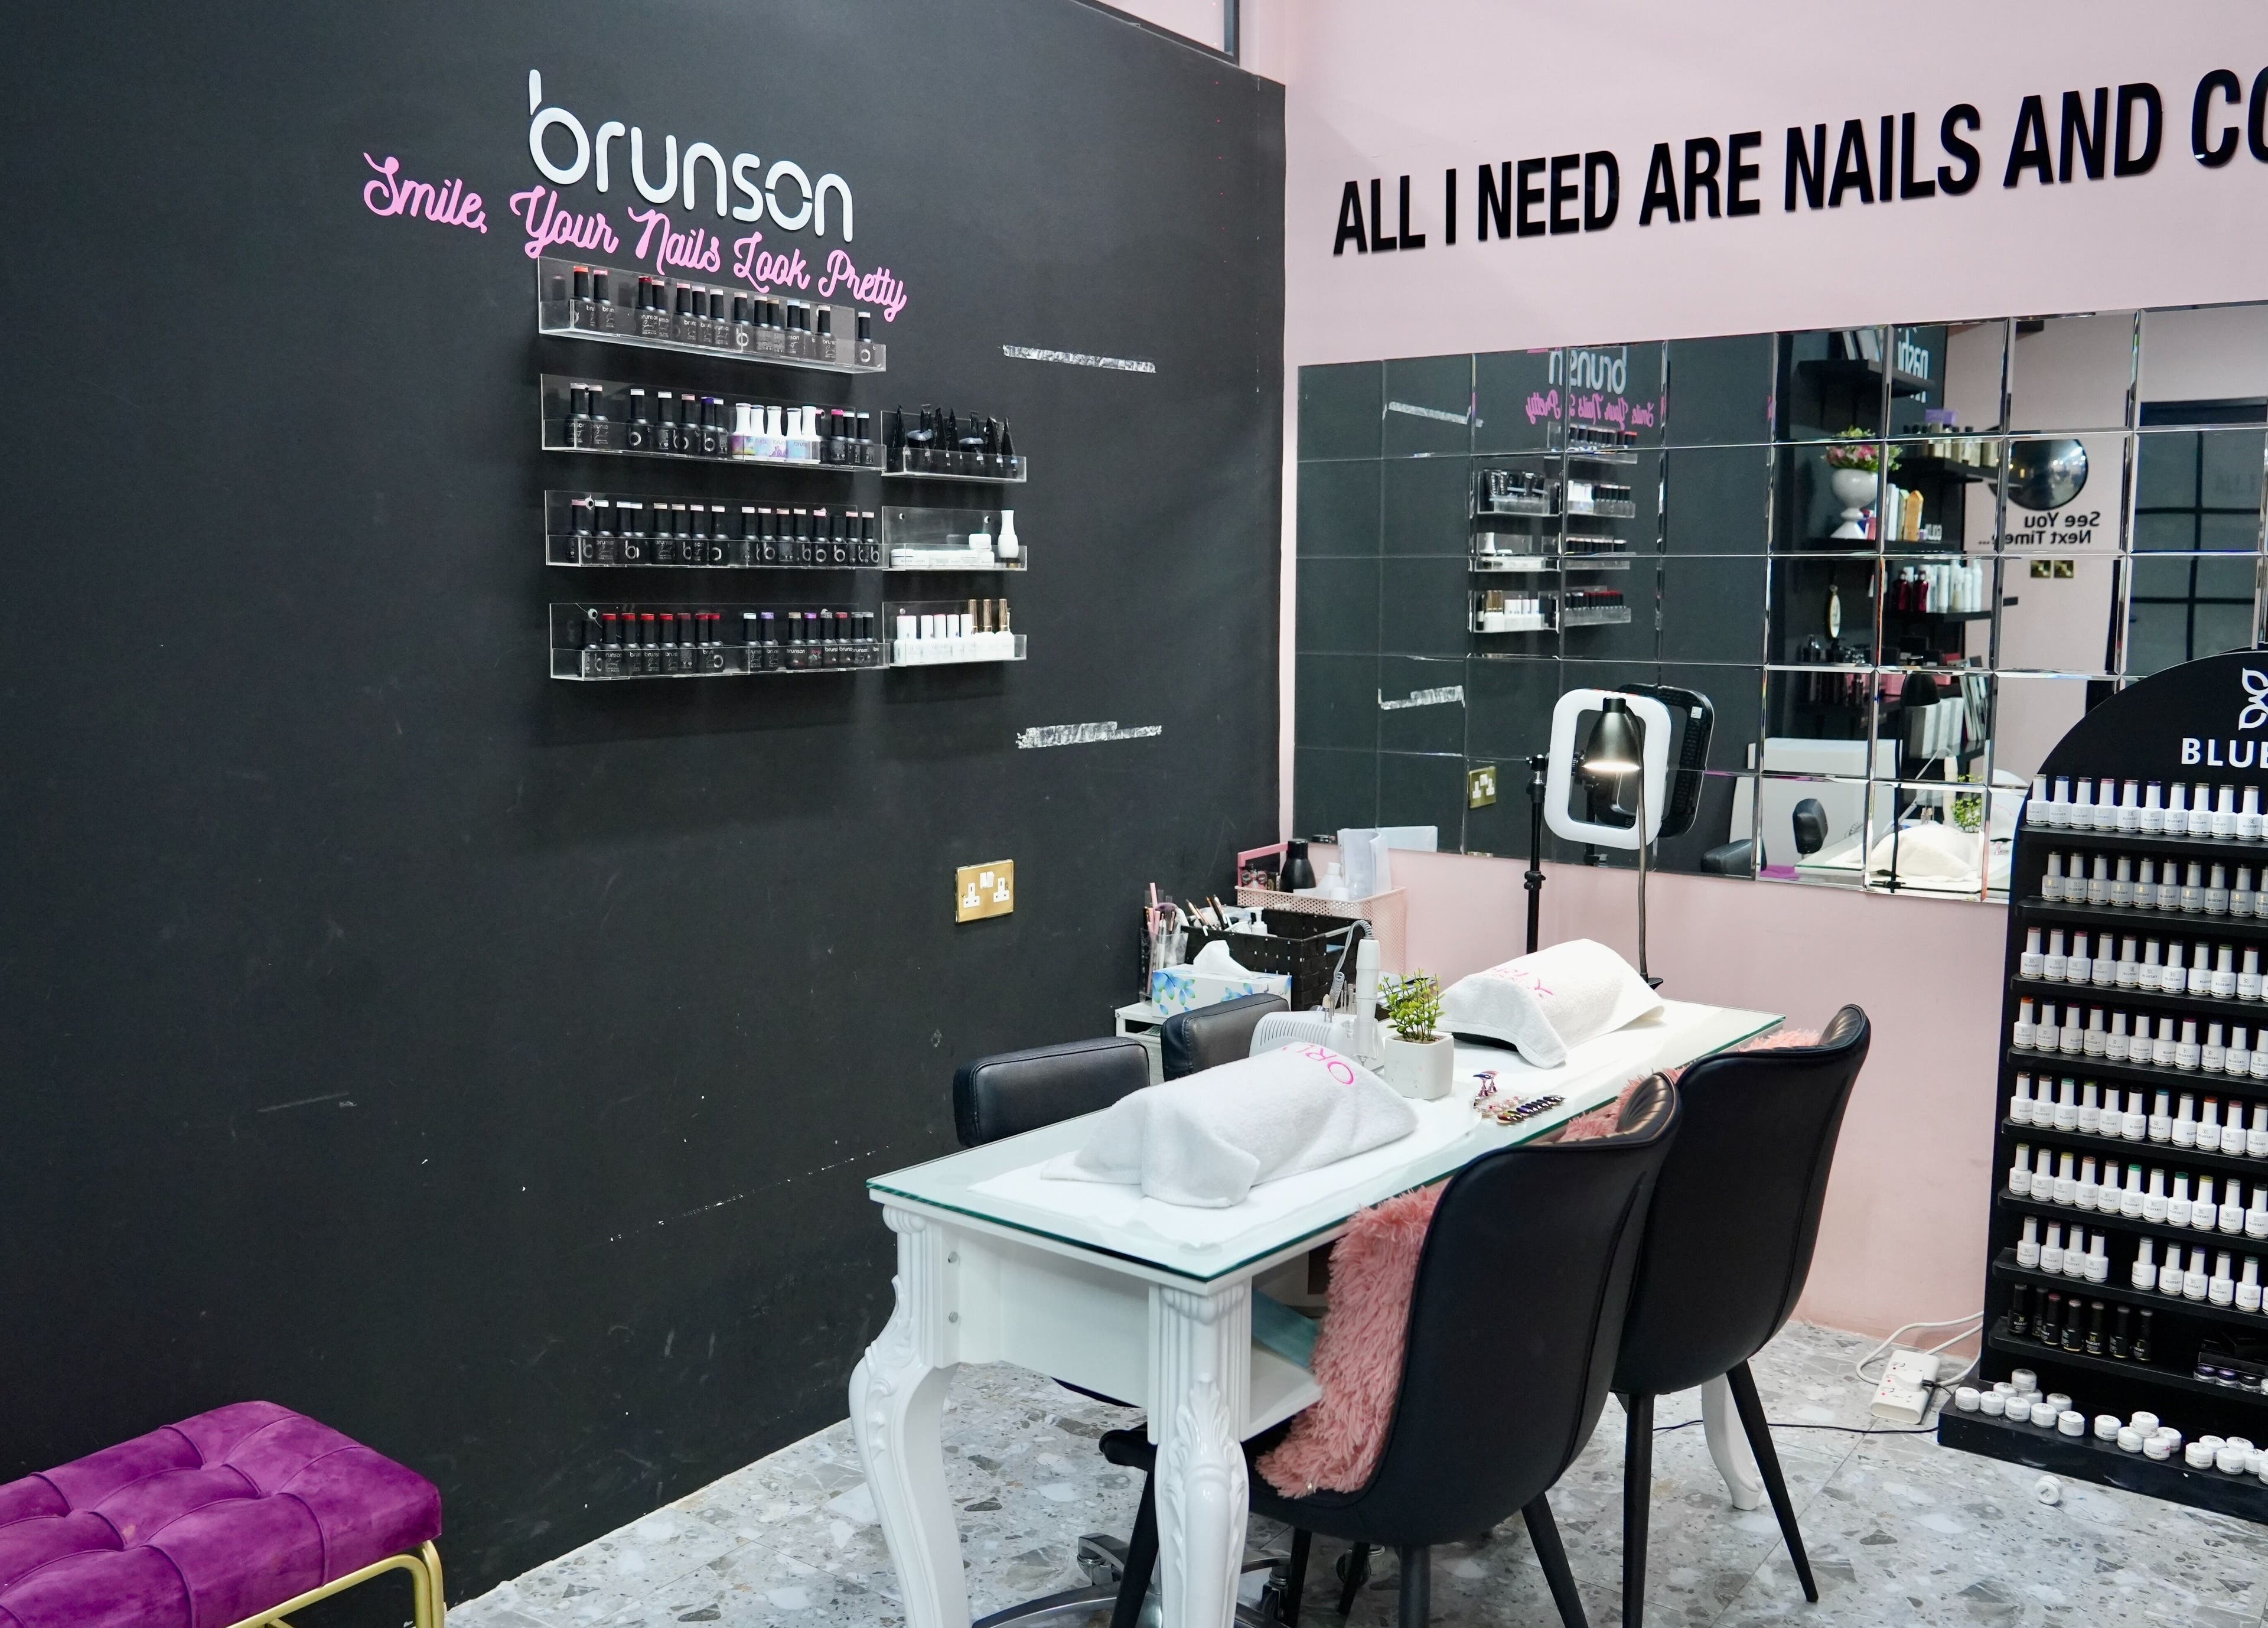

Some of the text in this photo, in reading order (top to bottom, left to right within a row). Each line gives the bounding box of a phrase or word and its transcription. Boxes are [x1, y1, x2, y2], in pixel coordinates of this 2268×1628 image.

[529, 69, 853, 242] brunson
[1333, 175, 1426, 255] ALL
[1445, 168, 1456, 246] I
[1478, 151, 1619, 242] NEED
[1639, 131, 1761, 226] ARE
[1784, 103, 1980, 212] NAILS
[2003, 82, 2163, 188] AND
[509, 184, 619, 259] Your
[628, 206, 721, 276] Nails
[734, 231, 810, 294] Look
[817, 249, 907, 323] Pretty
